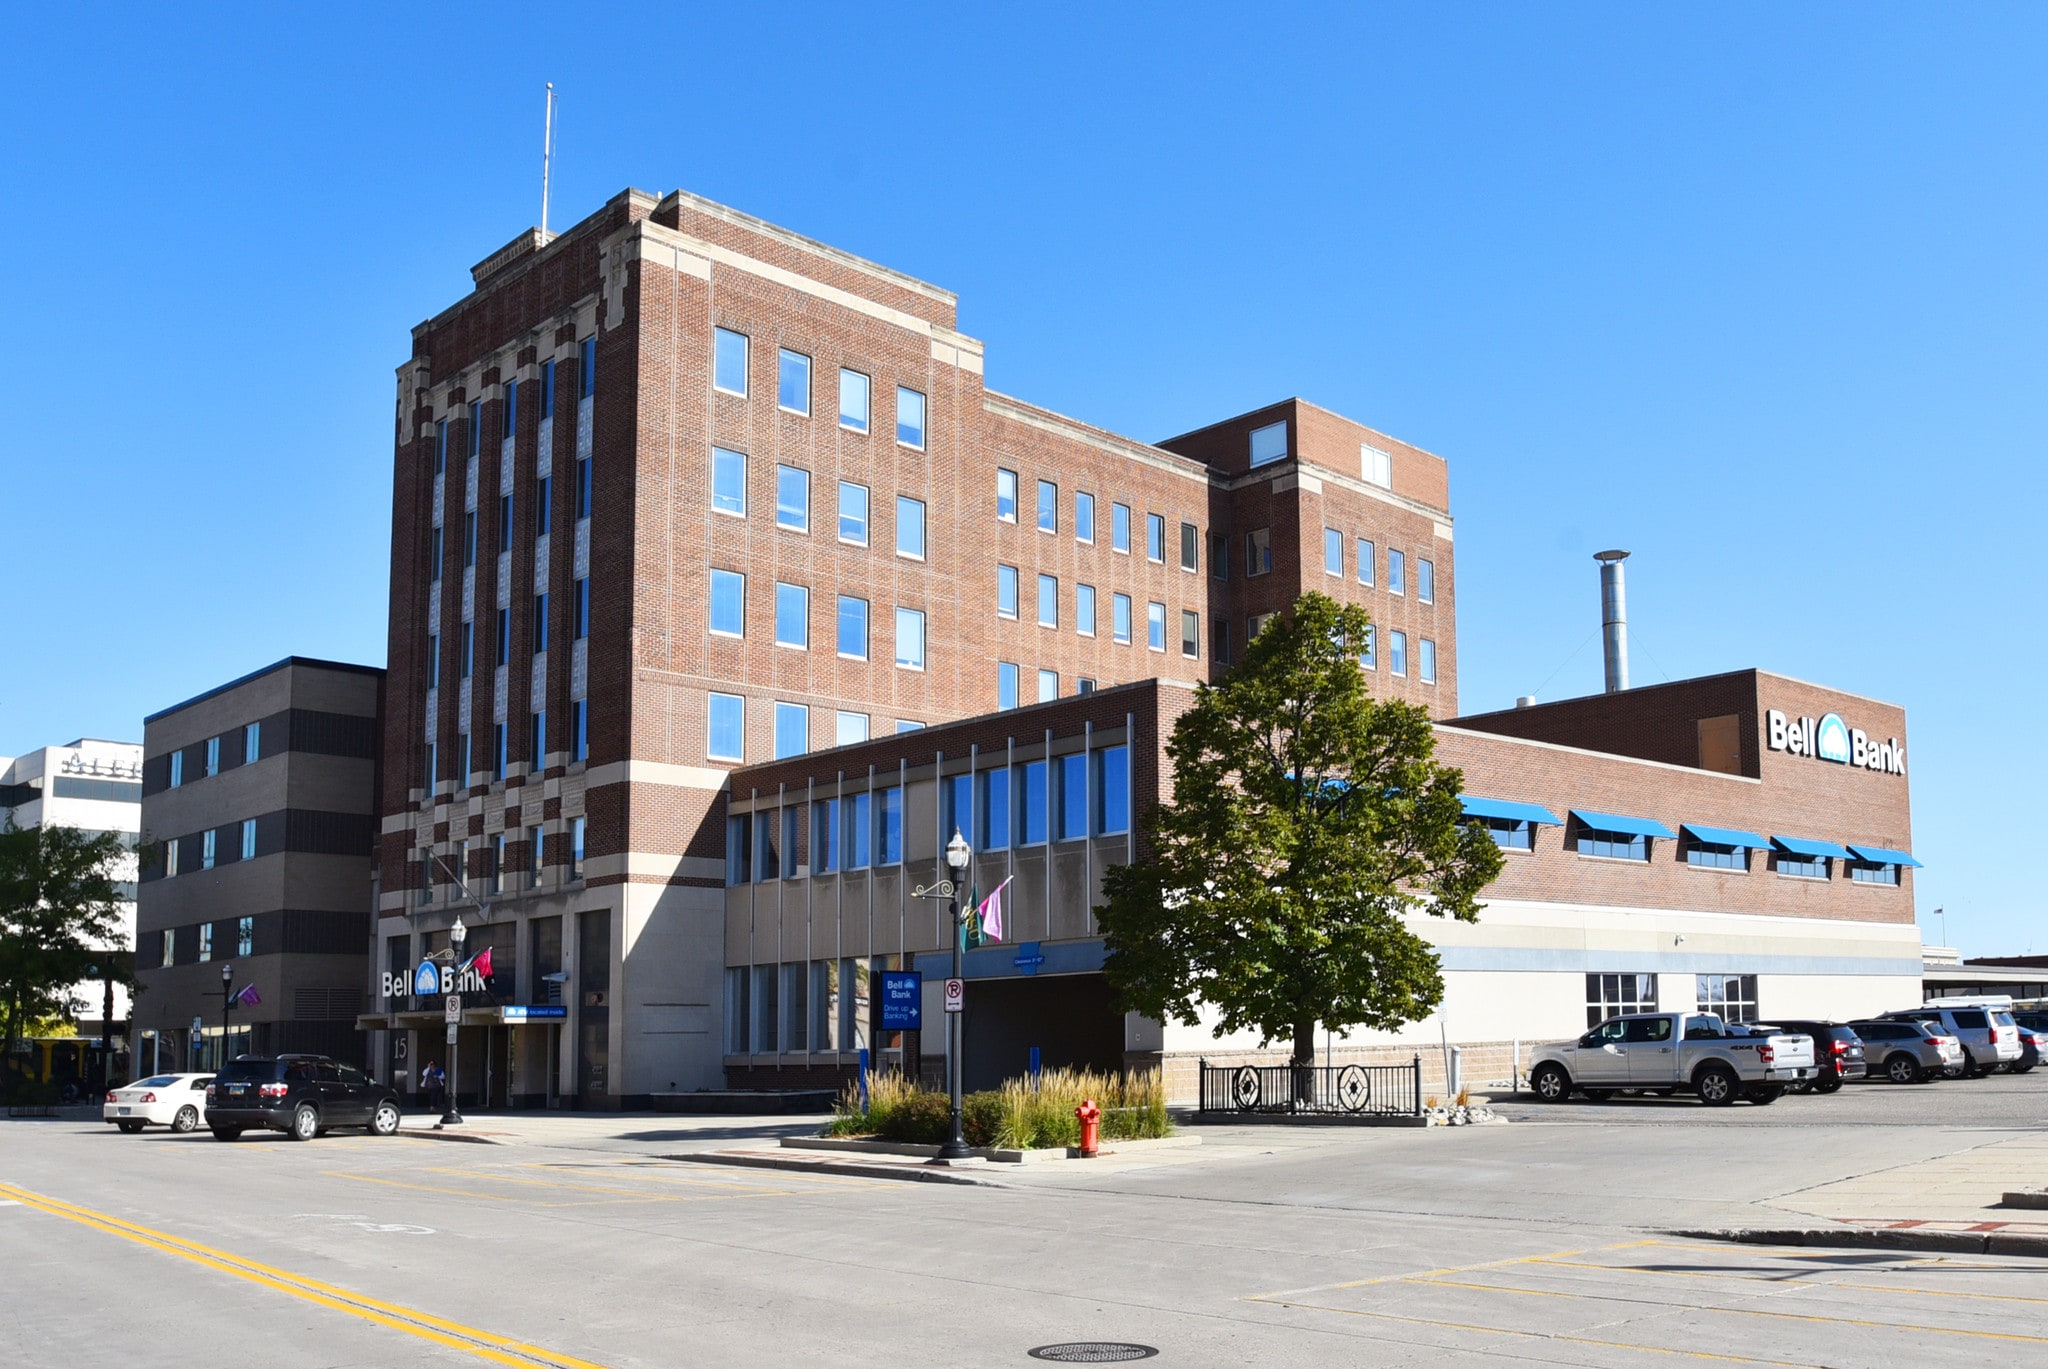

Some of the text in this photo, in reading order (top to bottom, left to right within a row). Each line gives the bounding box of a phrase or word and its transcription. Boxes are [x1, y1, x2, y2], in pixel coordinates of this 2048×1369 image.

[1766, 708, 1906, 774] Bell Bank
[382, 966, 487, 997] Bell Bank
[887, 980, 912, 999] Bell Bank
[883, 1004, 899, 1013] Drive
[883, 1012, 908, 1021] Banking
[394, 1038, 407, 1059] 15
